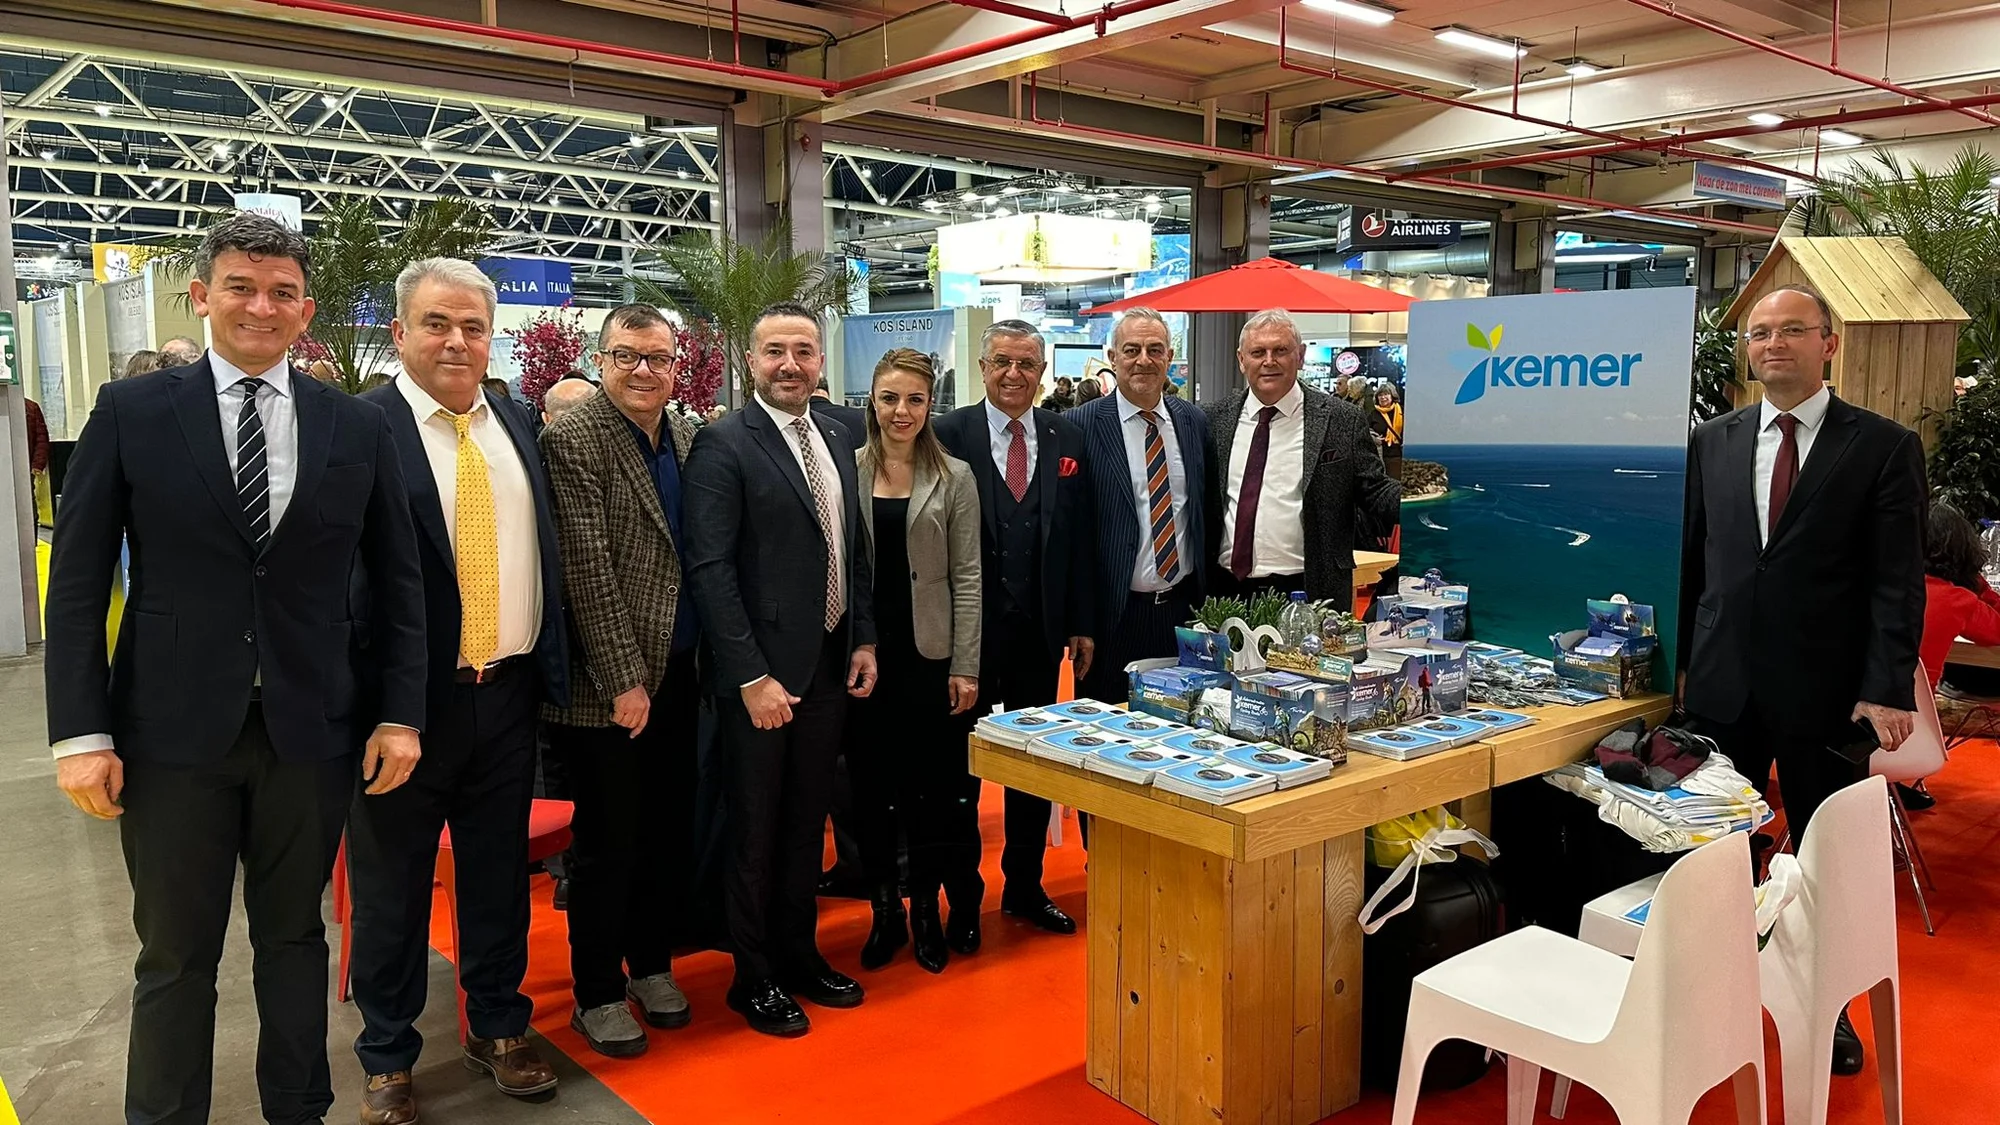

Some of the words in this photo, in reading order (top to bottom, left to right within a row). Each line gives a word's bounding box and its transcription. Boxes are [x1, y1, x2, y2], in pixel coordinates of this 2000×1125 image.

[1716, 176, 1724, 190] de
[1725, 179, 1738, 193] zon
[1390, 224, 1451, 236] AIRLINES
[496, 281, 538, 292] ALIA
[547, 282, 571, 294] ITALIA
[981, 296, 1001, 305] alpes
[873, 320, 893, 332] KOS
[895, 318, 933, 331] ISLAND
